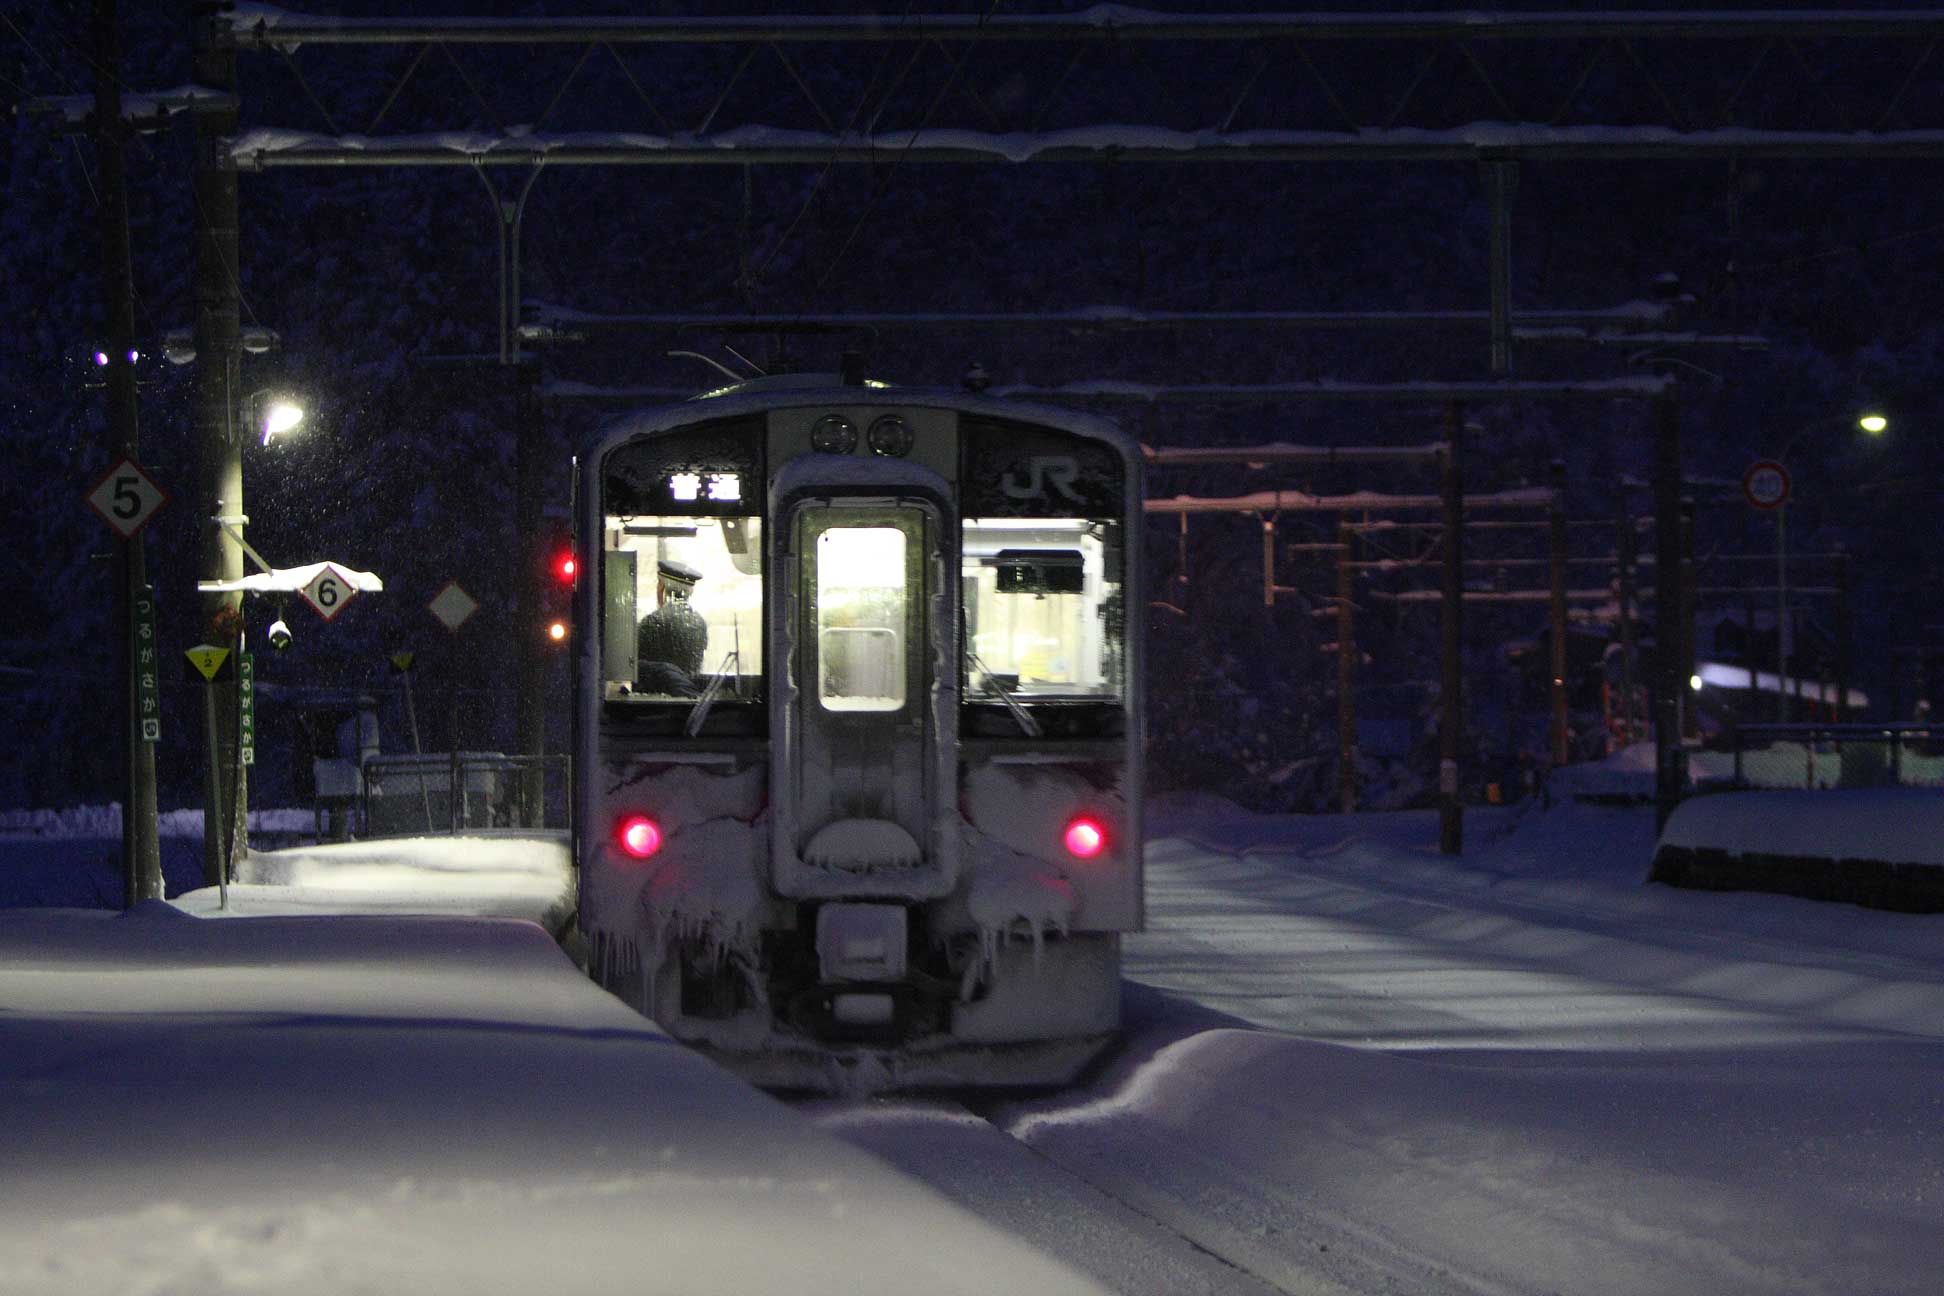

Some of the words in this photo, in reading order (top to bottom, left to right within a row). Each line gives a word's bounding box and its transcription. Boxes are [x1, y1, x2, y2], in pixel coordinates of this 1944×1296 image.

[113, 477, 142, 518] 5
[1002, 455, 1088, 504] JR
[320, 580, 337, 606] 6
[137, 600, 156, 713] つるがさか
[241, 662, 252, 744] つるがさか
